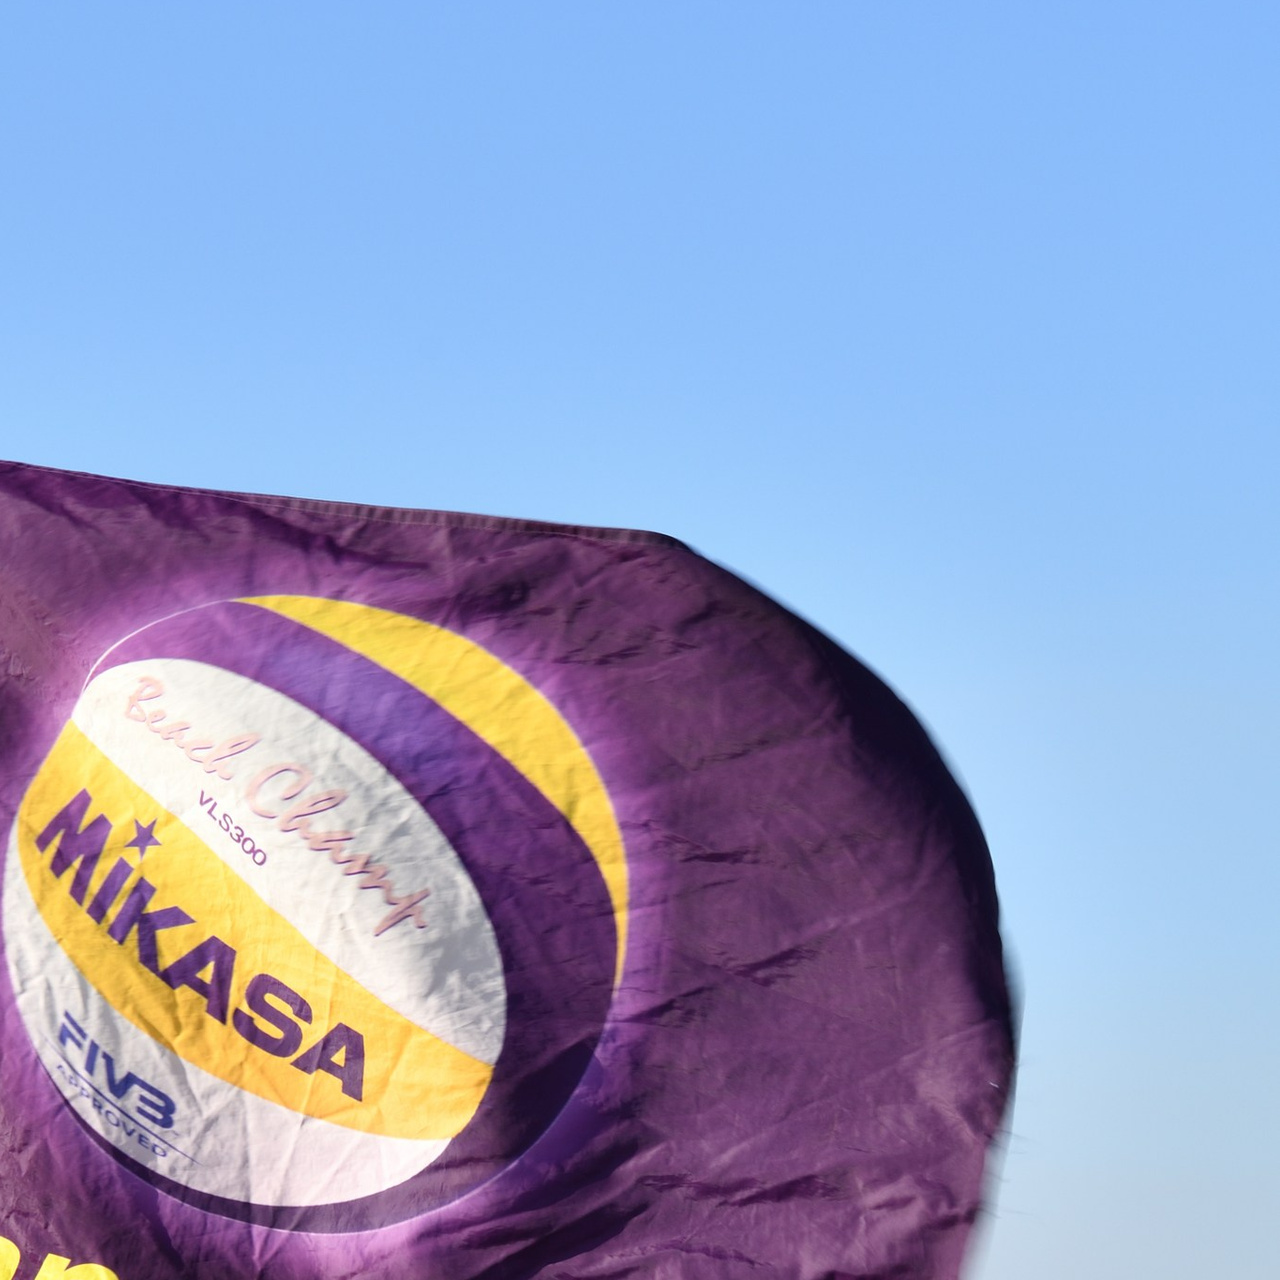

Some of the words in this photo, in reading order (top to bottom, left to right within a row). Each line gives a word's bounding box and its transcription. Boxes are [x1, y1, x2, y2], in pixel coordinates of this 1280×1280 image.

[124, 676, 262, 781] Beach
[246, 762, 431, 937] Champ
[198, 789, 267, 867] VLS300
